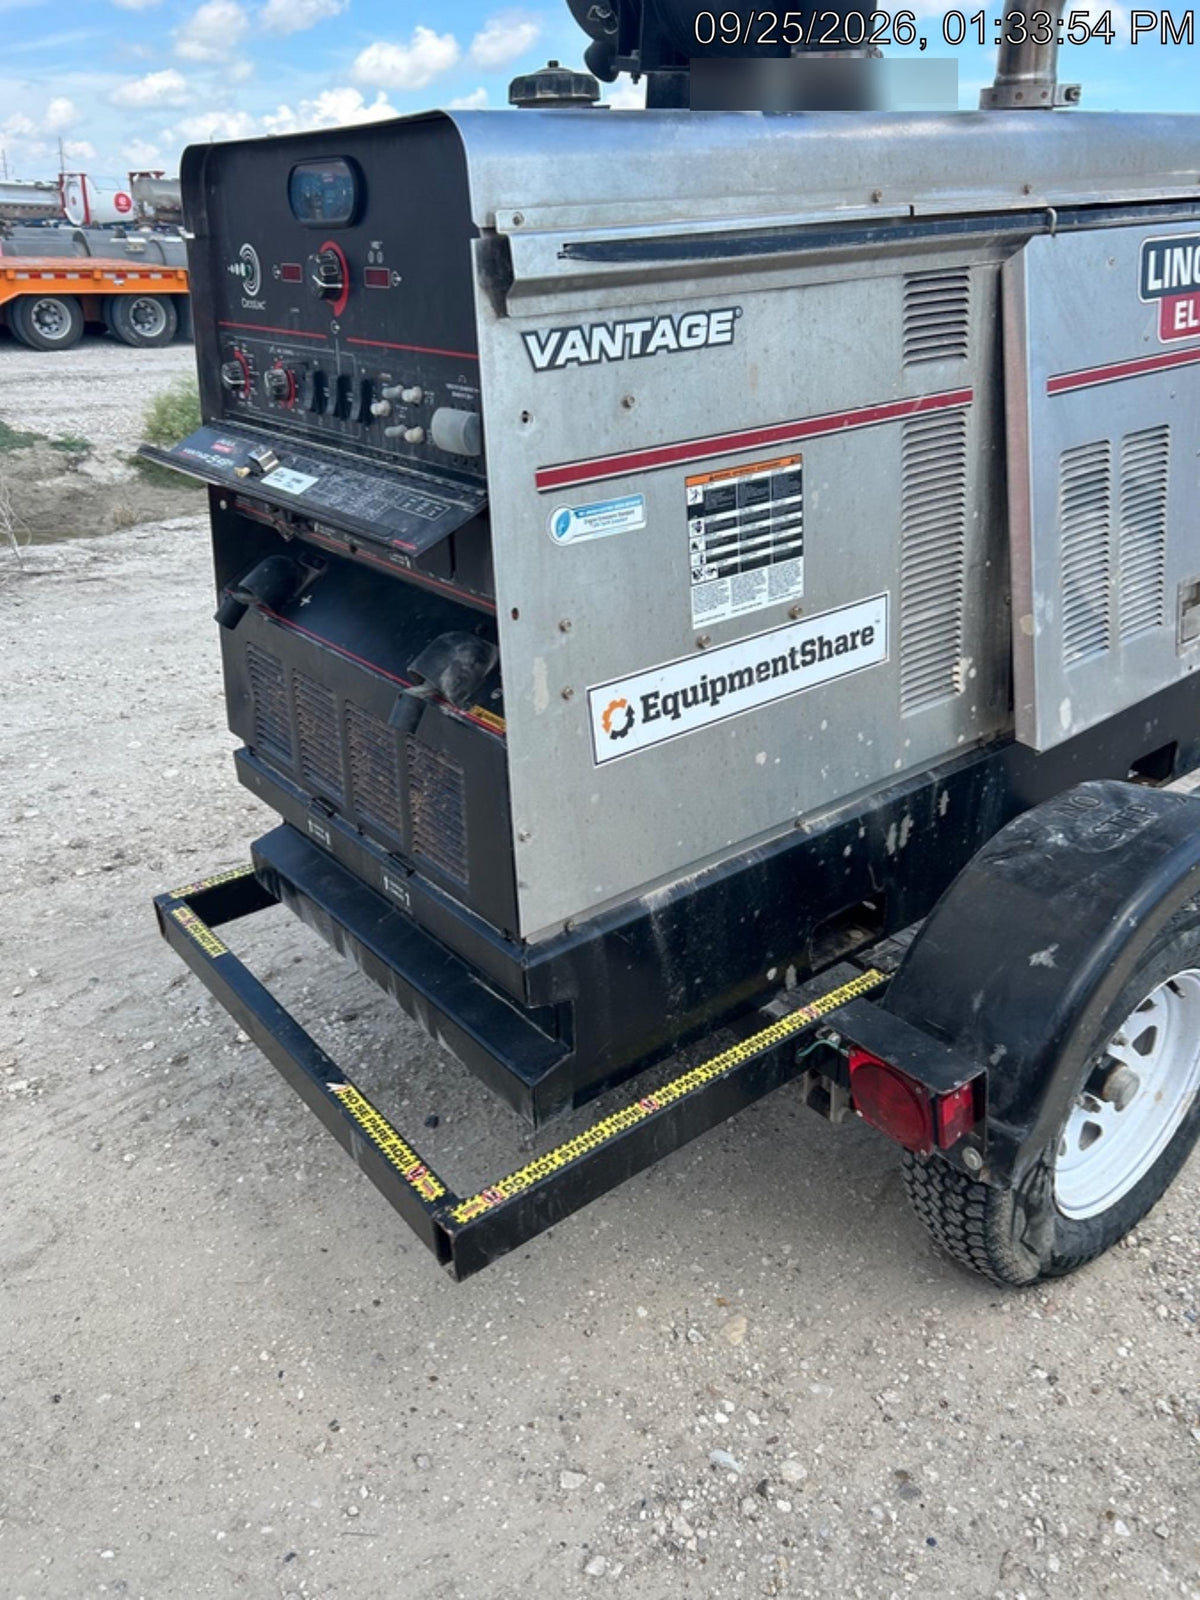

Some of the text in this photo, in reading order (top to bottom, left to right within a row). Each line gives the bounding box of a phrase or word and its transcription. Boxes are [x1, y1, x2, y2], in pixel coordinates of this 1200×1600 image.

[522, 307, 737, 371] VANTAGE
[640, 624, 875, 724] EquipmentShare
[1052, 795, 1103, 819] NO
[342, 1089, 415, 1168] NO SE PARE AQUI
[502, 1175, 526, 1193] DO
[526, 1159, 557, 1178] NOT
[557, 1130, 607, 1159] STAND
[604, 1107, 642, 1130] HERE
[656, 1088, 675, 1102] NE
[676, 1073, 702, 1091] PAS
[700, 1050, 739, 1075] TENEZ
[740, 1024, 787, 1054] DEBOUT
